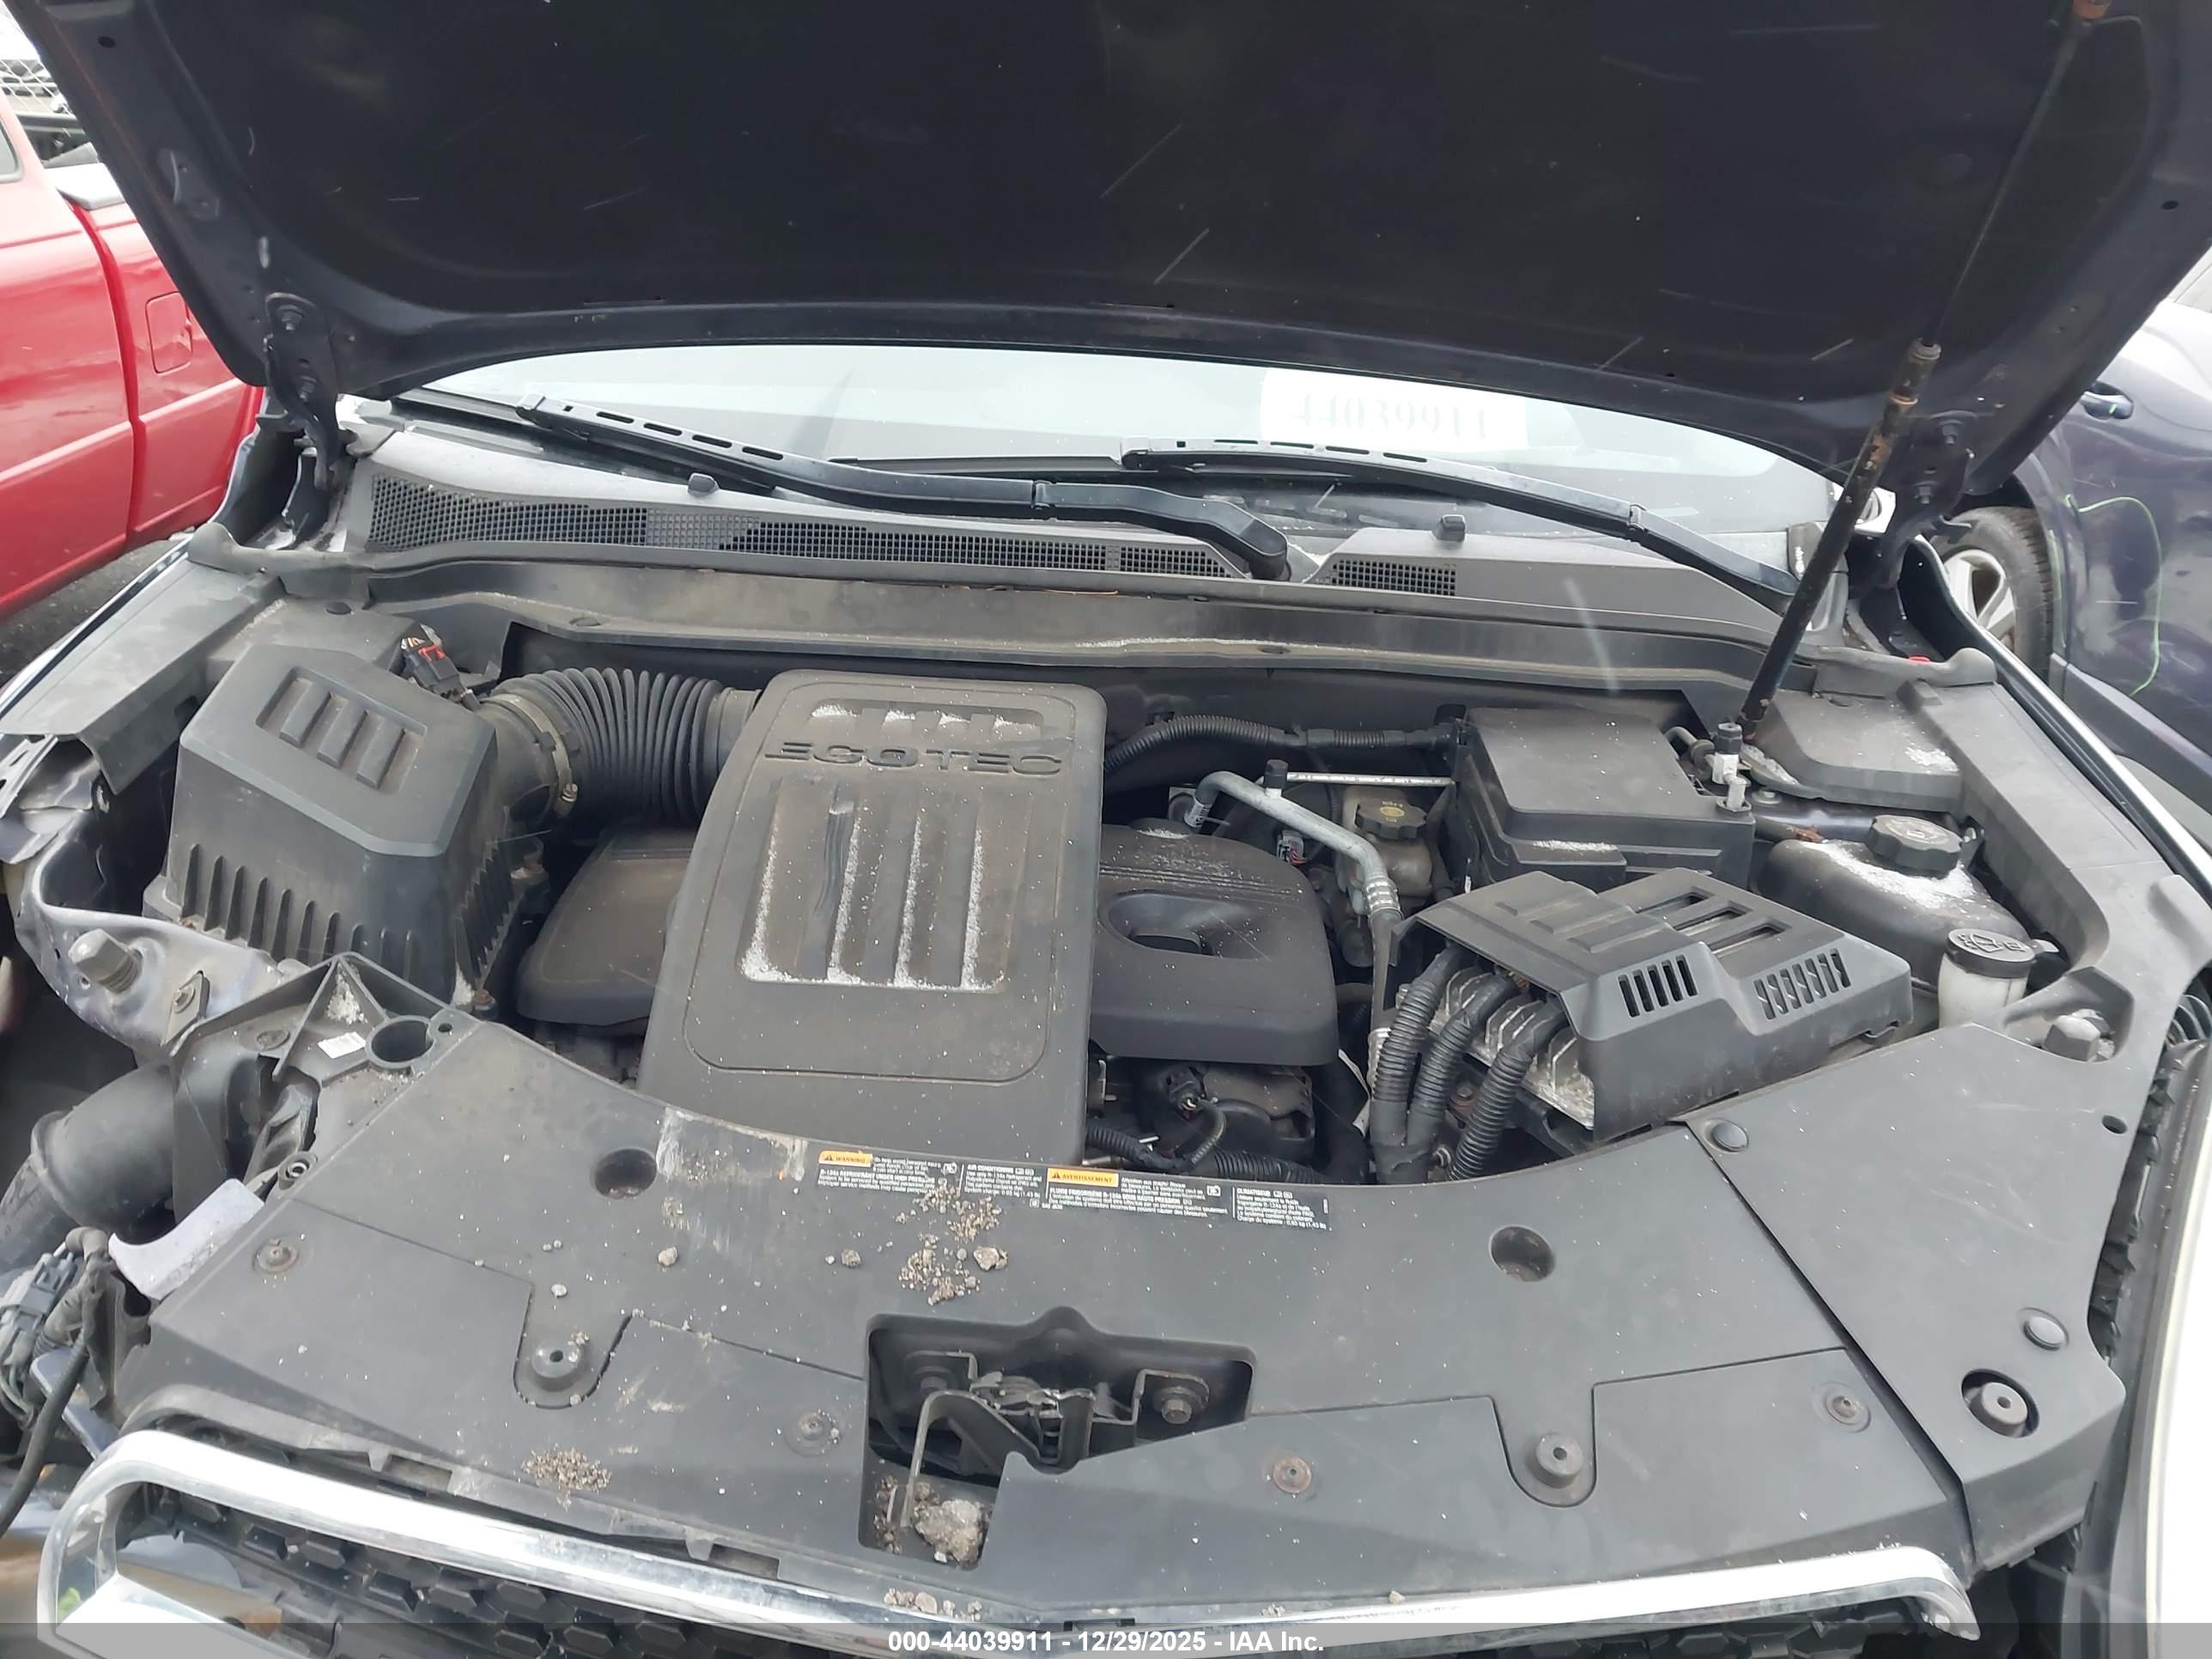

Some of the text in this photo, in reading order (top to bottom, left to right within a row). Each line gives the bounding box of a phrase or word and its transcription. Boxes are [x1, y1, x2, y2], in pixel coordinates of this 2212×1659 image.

[1291, 392, 1487, 440] 44039911
[764, 741, 1063, 776] ECOTEC
[836, 1155, 866, 1164] WARNING
[1062, 1174, 1113, 1183] AVERTISSEMENT
